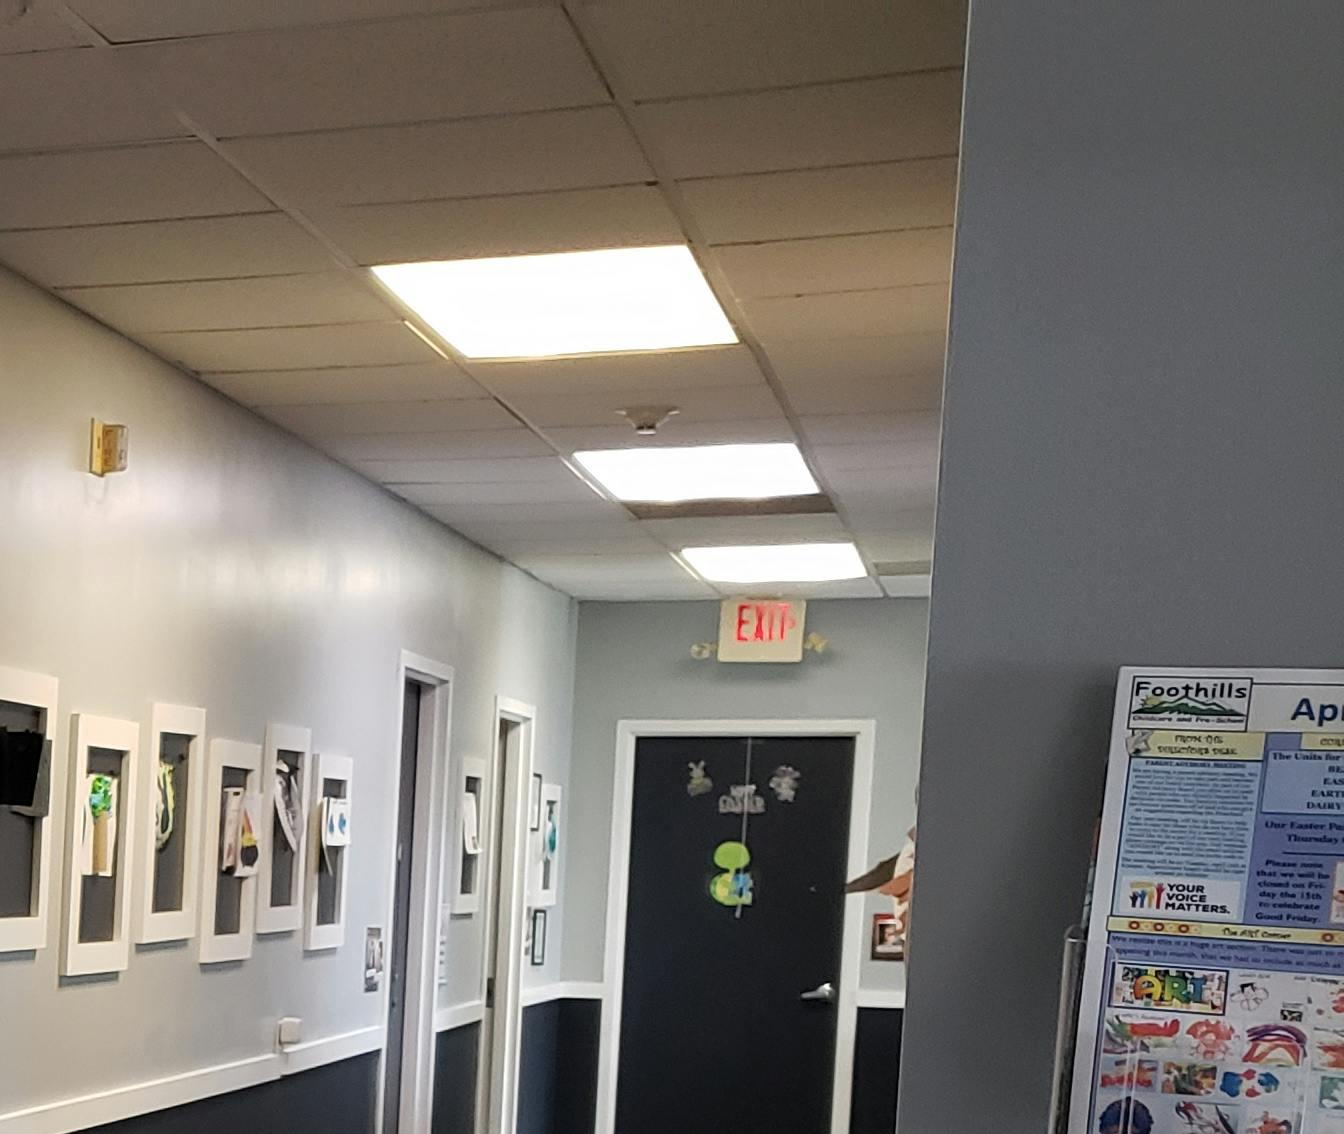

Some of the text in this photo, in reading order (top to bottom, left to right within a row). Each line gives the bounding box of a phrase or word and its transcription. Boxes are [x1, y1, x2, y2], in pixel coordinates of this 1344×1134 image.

[736, 604, 791, 641] EXIT
[1135, 681, 1247, 699] Foothills
[1290, 697, 1344, 728] Ap
[1273, 752, 1342, 761] The Units for
[1306, 801, 1341, 811] DAIRY
[1265, 821, 1287, 829] Our
[1290, 822, 1326, 830] Easter
[1287, 834, 1338, 844] Thursday
[1256, 869, 1277, 877] that
[1167, 882, 1205, 894] YOUR
[1257, 880, 1290, 888] closed
[1166, 892, 1207, 903] VOICE
[1259, 891, 1276, 900] day
[1280, 891, 1297, 899] the
[1164, 902, 1231, 914] MATTERS.
[1272, 901, 1321, 910] celebrate
[1255, 912, 1319, 924] Good Friday
